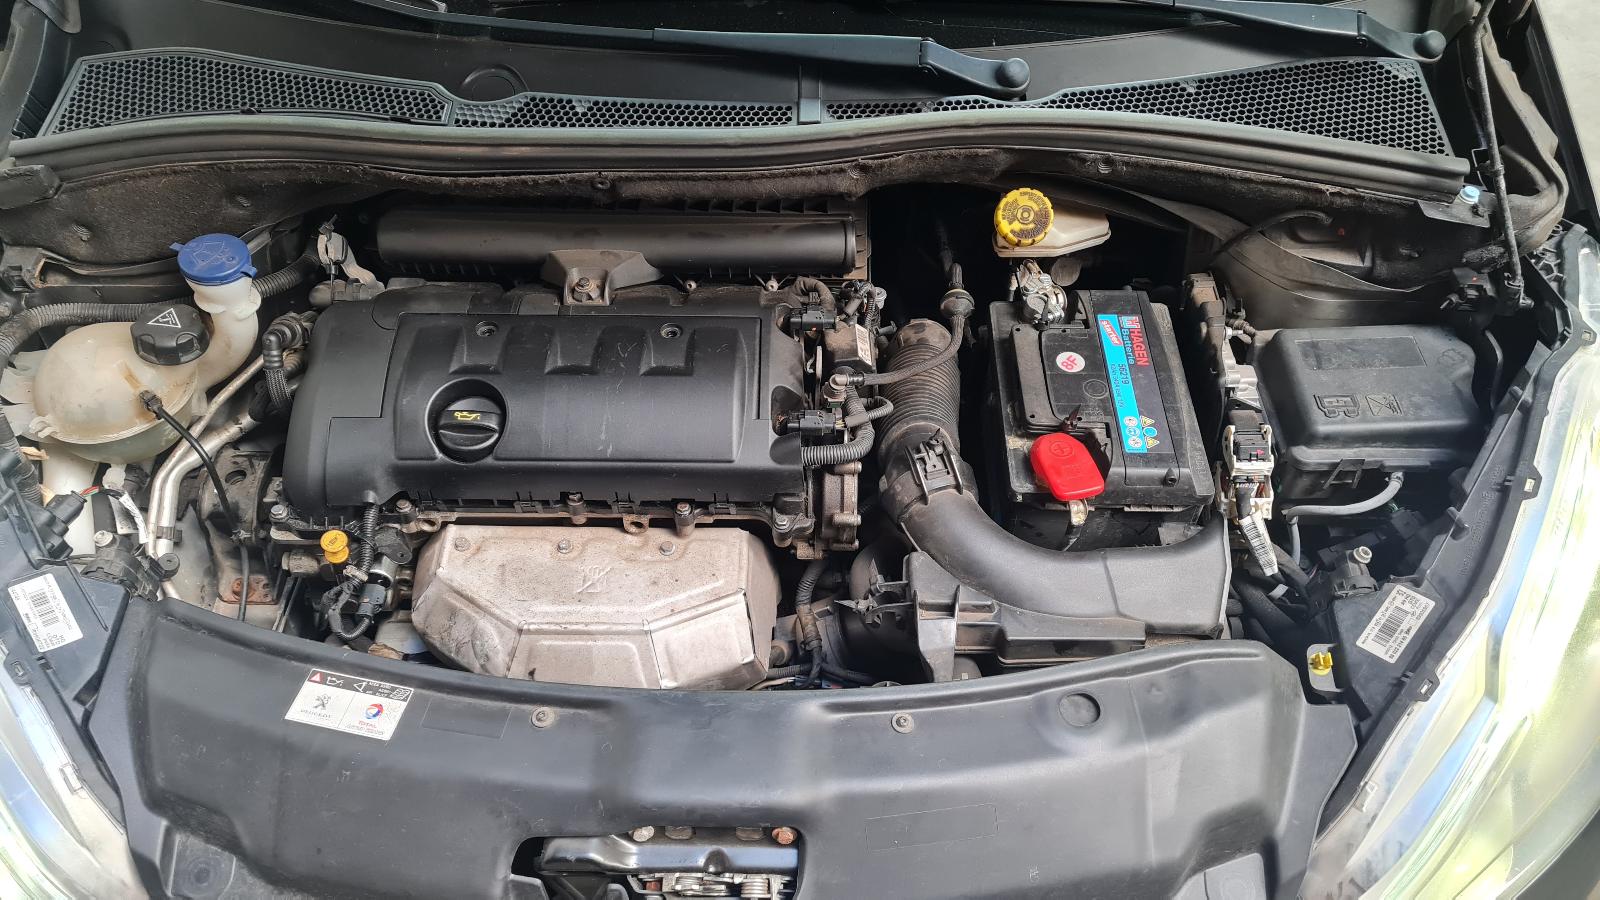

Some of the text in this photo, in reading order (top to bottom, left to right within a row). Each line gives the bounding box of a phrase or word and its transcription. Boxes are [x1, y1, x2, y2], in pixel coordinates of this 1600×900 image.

[1101, 320, 1121, 345] starter
[1121, 328, 1135, 365] Batterie
[1130, 328, 1150, 367] HAGEN
[1117, 363, 1130, 385] 56219
